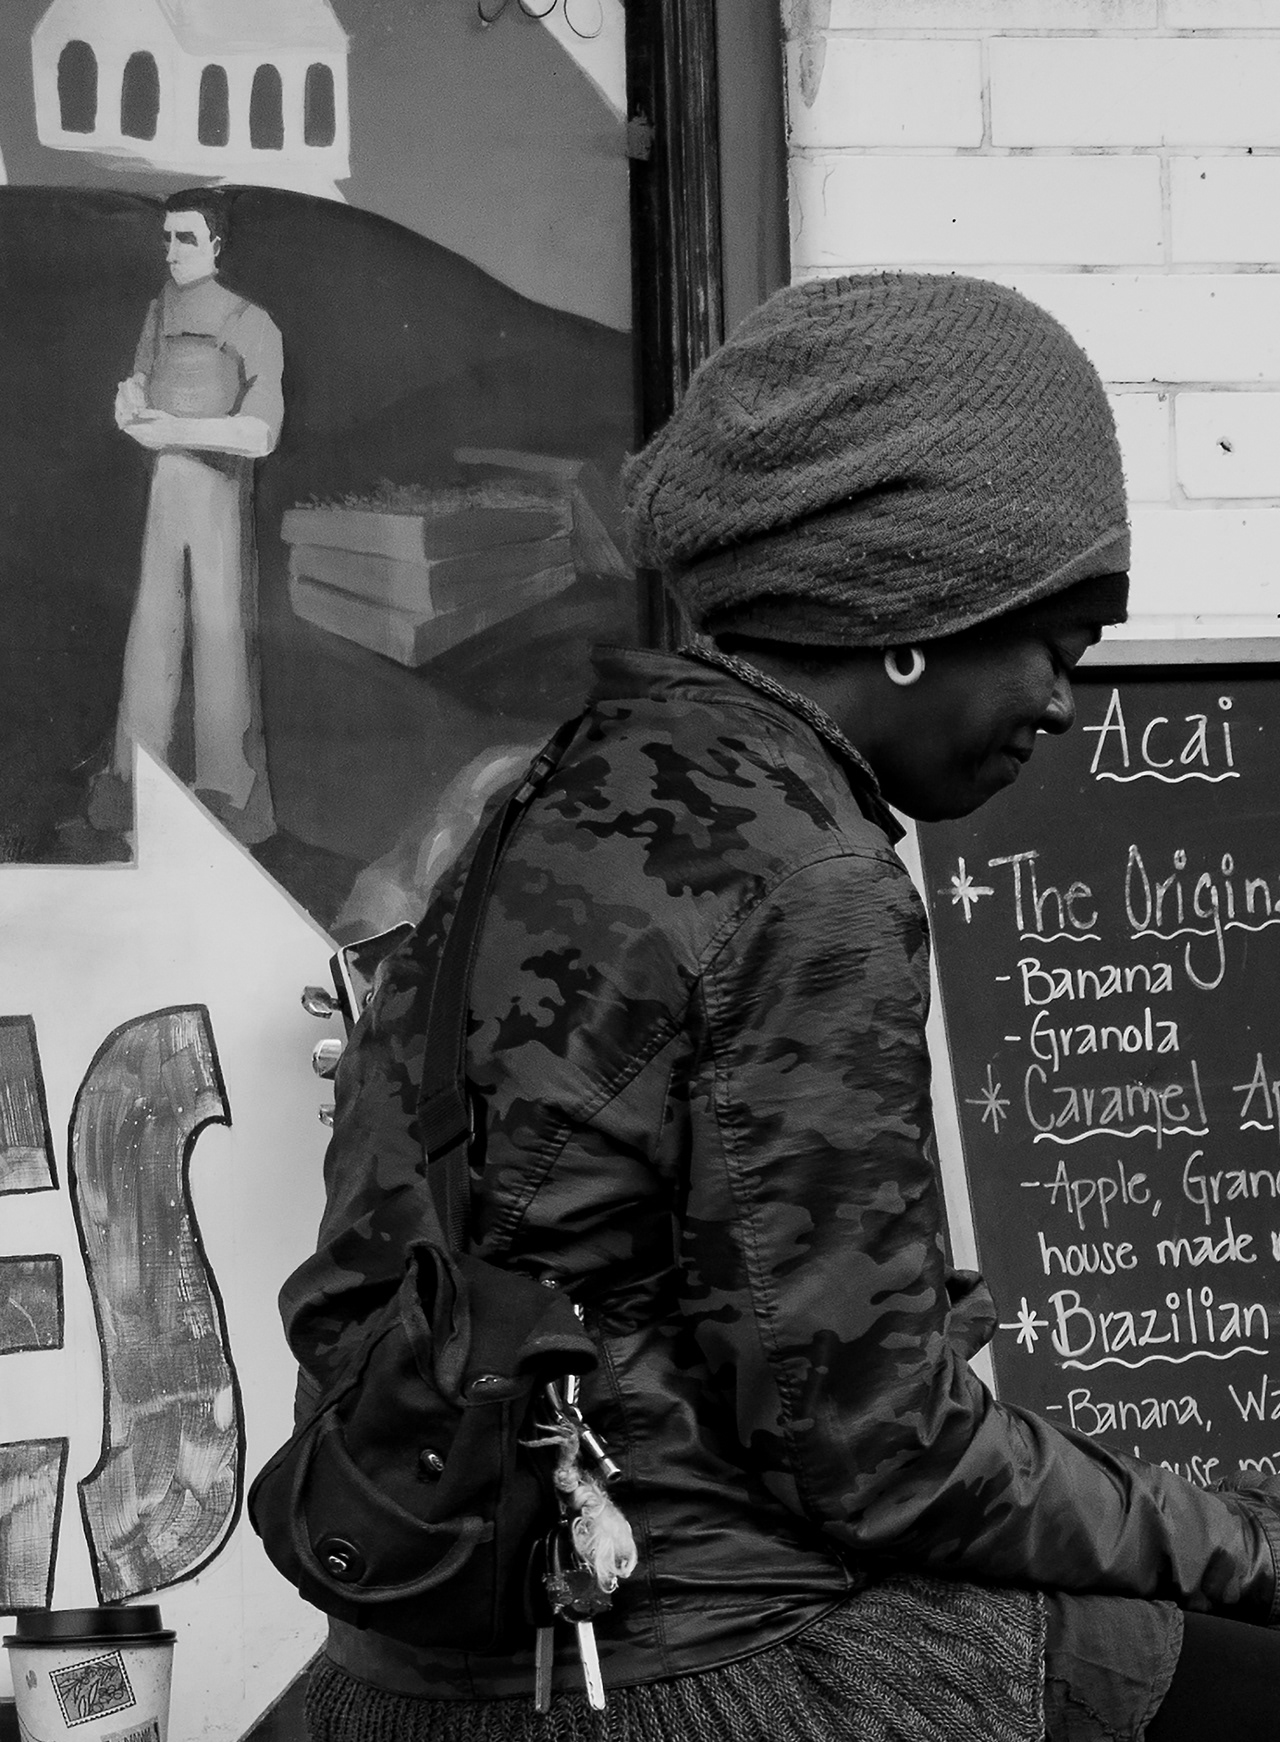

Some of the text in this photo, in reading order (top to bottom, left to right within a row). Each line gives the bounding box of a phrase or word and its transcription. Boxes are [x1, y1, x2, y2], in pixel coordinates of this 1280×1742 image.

[1083, 689, 1238, 773] Acai
[989, 851, 1098, 932] The
[1025, 1060, 1208, 1149] Caramel
[1038, 1231, 1138, 1275] house
[1157, 1217, 1257, 1267] made
[1051, 1289, 1270, 1356] Brazilian
